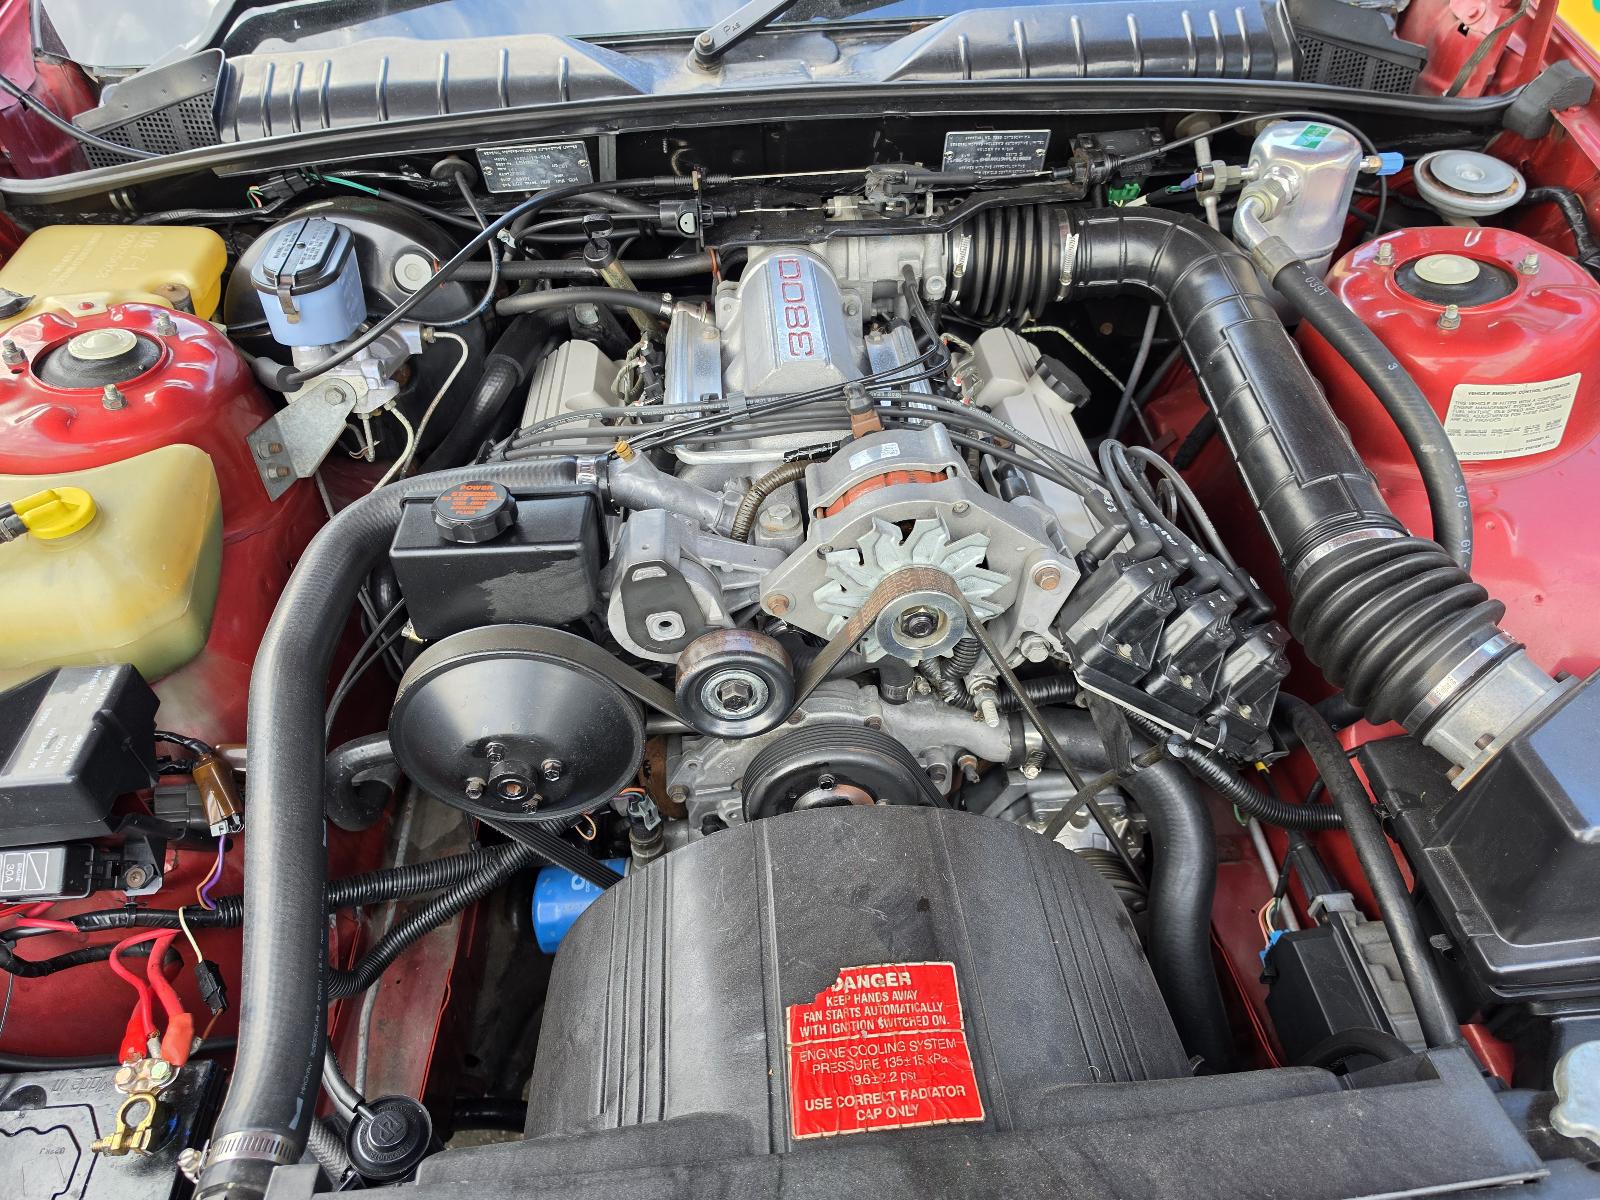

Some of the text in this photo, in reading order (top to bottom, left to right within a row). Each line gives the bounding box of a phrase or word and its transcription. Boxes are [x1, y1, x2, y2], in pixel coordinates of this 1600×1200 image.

[778, 258, 815, 357] 3800
[1454, 485, 1468, 508] 5/8
[1460, 539, 1471, 555] GY
[4, 863, 15, 884] 30A
[831, 972, 912, 992] DANGER
[826, 990, 918, 1007] KEEP HANDS AWAY
[803, 1002, 943, 1023] FAN STARTS AUTOMATICALLY
[799, 1014, 950, 1038] WITH IGNITION SWITCHED ON.
[800, 1037, 957, 1063] ENGINE COOLING SYSTEM
[812, 1059, 881, 1075] PRESSURE
[804, 1085, 966, 1112] USE CORRECT RADIATOR
[856, 1104, 919, 1122] CAP ONLY
